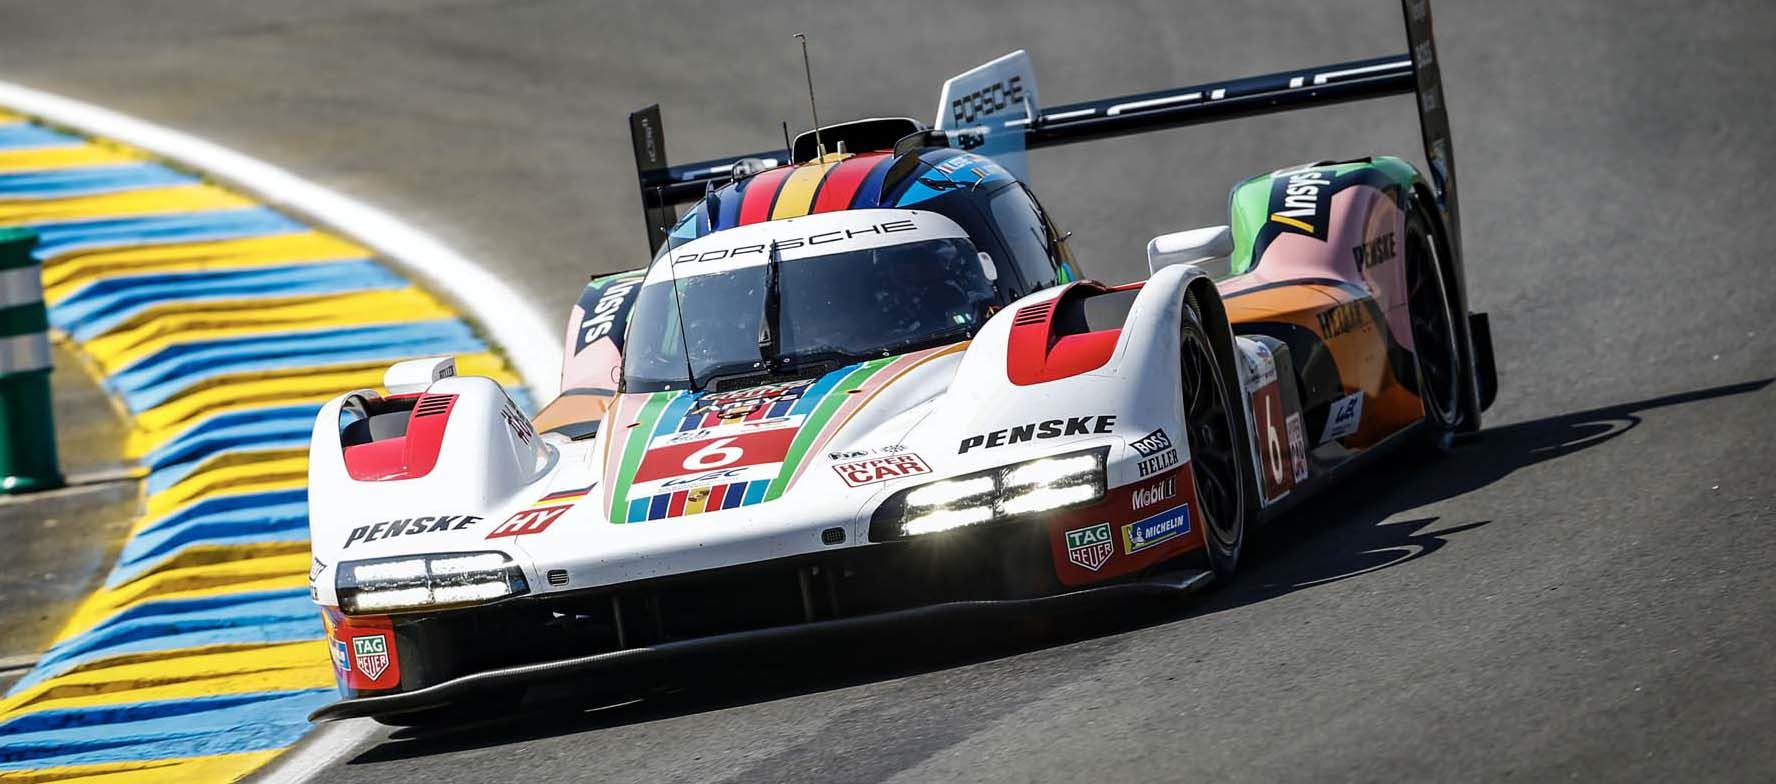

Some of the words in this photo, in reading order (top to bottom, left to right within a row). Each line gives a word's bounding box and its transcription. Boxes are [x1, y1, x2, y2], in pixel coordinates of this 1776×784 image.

[953, 75, 1024, 128] PORSCHE
[1271, 172, 1331, 233] Ansys
[671, 219, 919, 268] PORSCHE
[1352, 231, 1396, 273] PENSKE
[957, 415, 1117, 455] PENSKE
[1132, 432, 1169, 455] BOSS
[1265, 395, 1284, 485] 6
[682, 437, 744, 471] 6
[839, 455, 915, 473] HYPER
[1137, 448, 1179, 478] HELLER
[847, 461, 926, 483] CAR
[1131, 479, 1165, 512] Mobil
[342, 514, 485, 550] PENSKE
[498, 506, 562, 537] HY
[1070, 527, 1109, 546] TAG
[1144, 514, 1185, 540] MICHELIN
[1072, 543, 1112, 568] HEUER
[355, 639, 384, 654] TAG
[357, 655, 387, 677] HEUER
